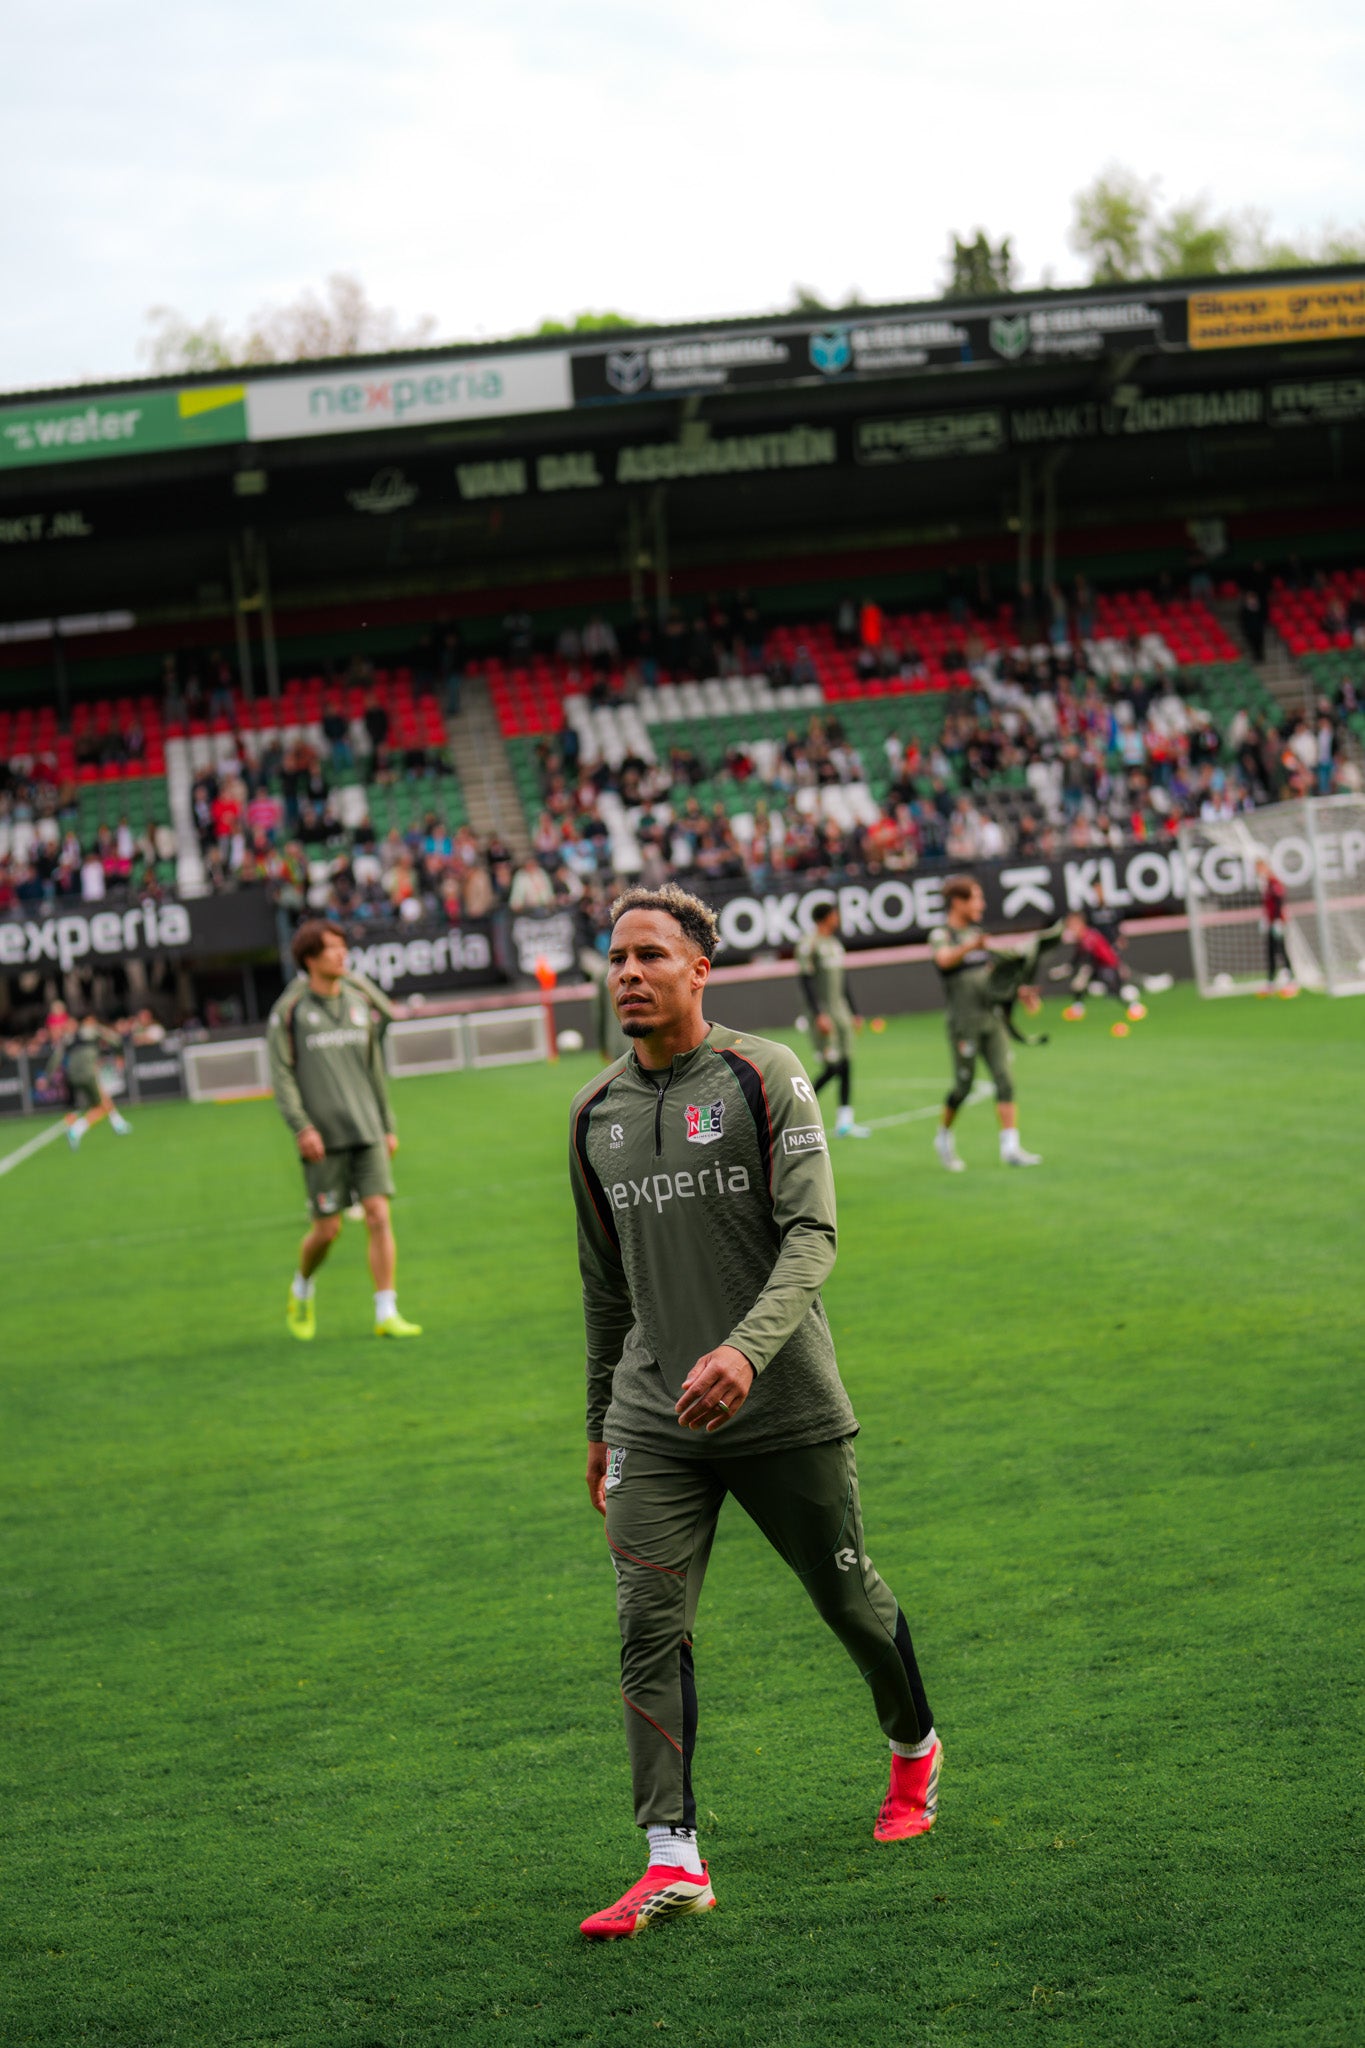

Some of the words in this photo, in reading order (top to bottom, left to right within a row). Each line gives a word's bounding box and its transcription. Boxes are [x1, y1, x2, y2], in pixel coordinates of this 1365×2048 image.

[308, 363, 503, 418] nexperia
[35, 406, 143, 447] water
[0, 897, 192, 973] experia
[343, 928, 491, 992] xperia
[690, 1117, 720, 1133] NEC
